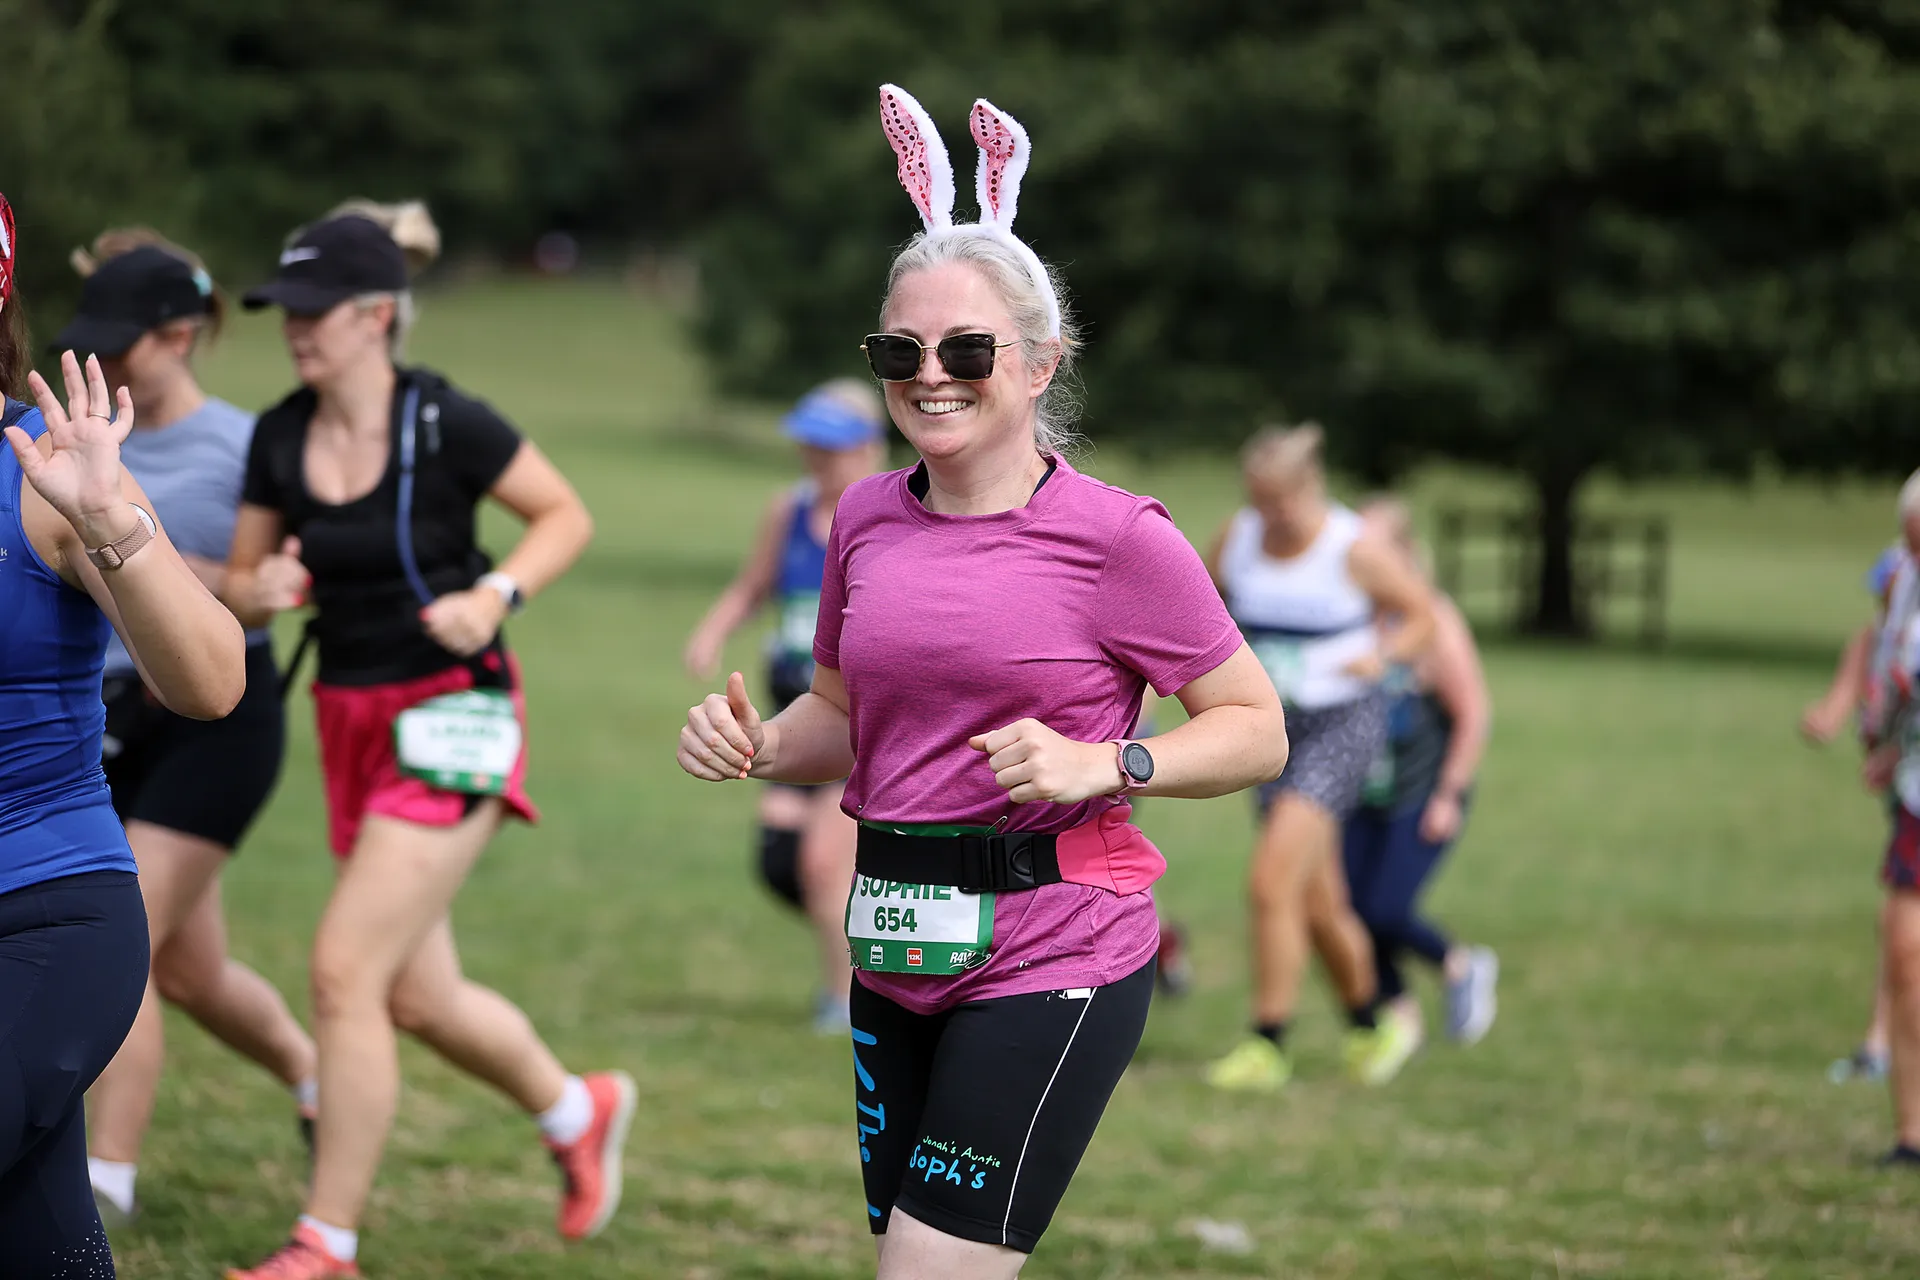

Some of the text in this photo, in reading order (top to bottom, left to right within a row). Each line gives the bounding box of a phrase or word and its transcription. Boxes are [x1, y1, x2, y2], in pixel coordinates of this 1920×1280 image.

[860, 876, 952, 901] SOPHIE
[874, 906, 918, 932] 654
[858, 1101, 885, 1163] The
[909, 1144, 987, 1190] Soph's
[922, 1135, 1001, 1168] Jonah's Auntie
